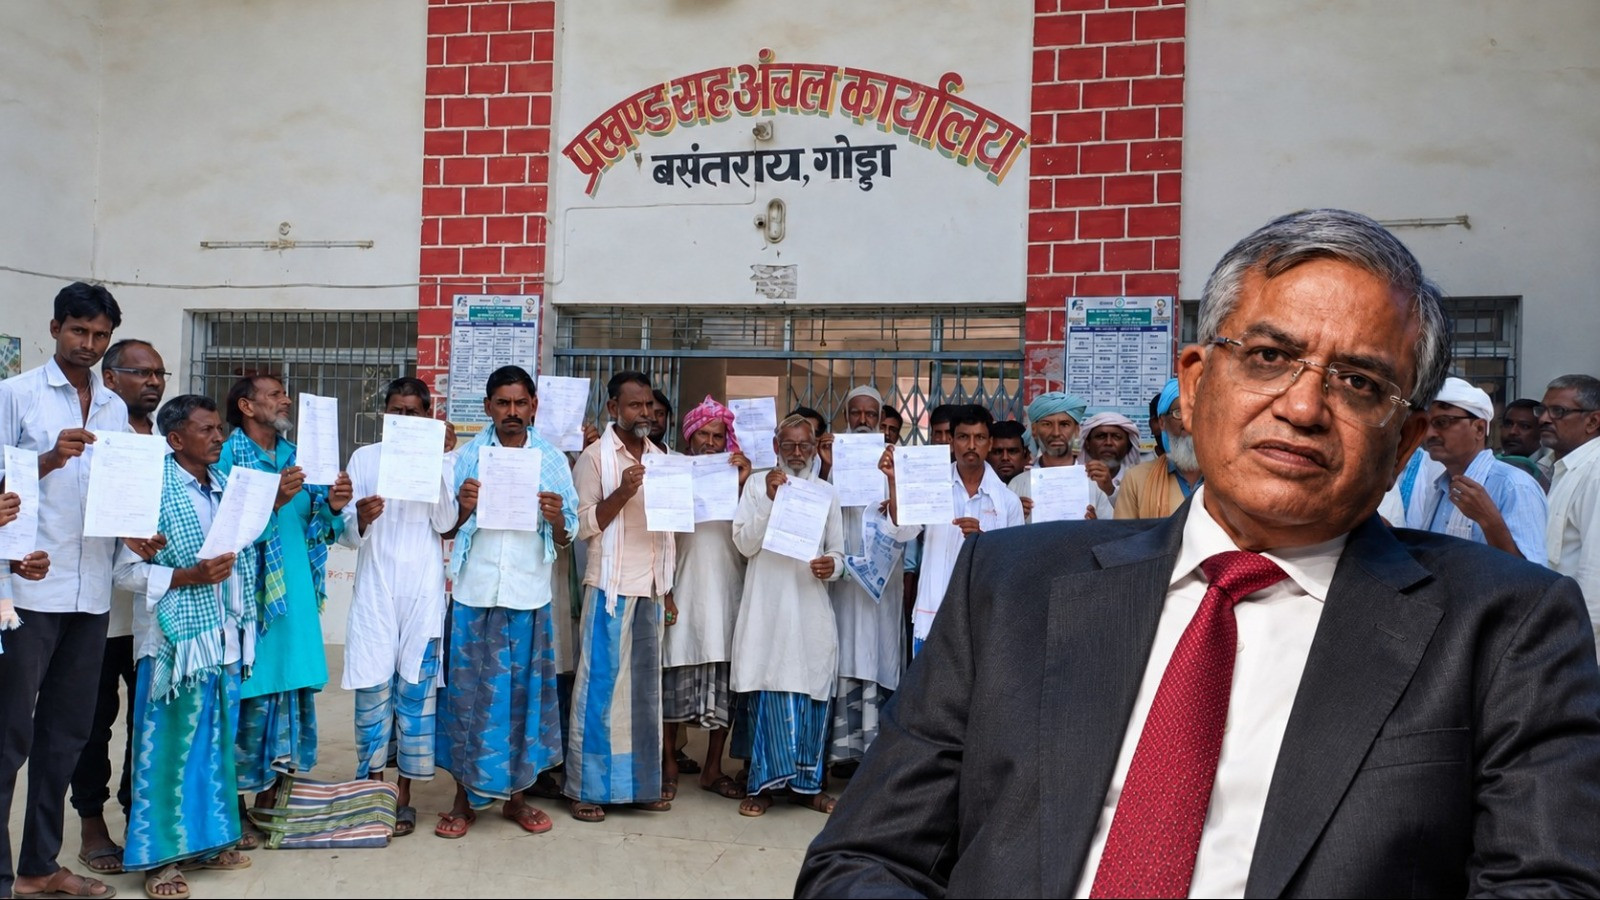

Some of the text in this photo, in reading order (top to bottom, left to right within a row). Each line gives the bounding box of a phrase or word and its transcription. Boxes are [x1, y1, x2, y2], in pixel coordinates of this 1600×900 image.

[561, 48, 1030, 198] प्रखण्ड सह अंचल कार्यालय
[812, 134, 898, 192] गोड्डा
